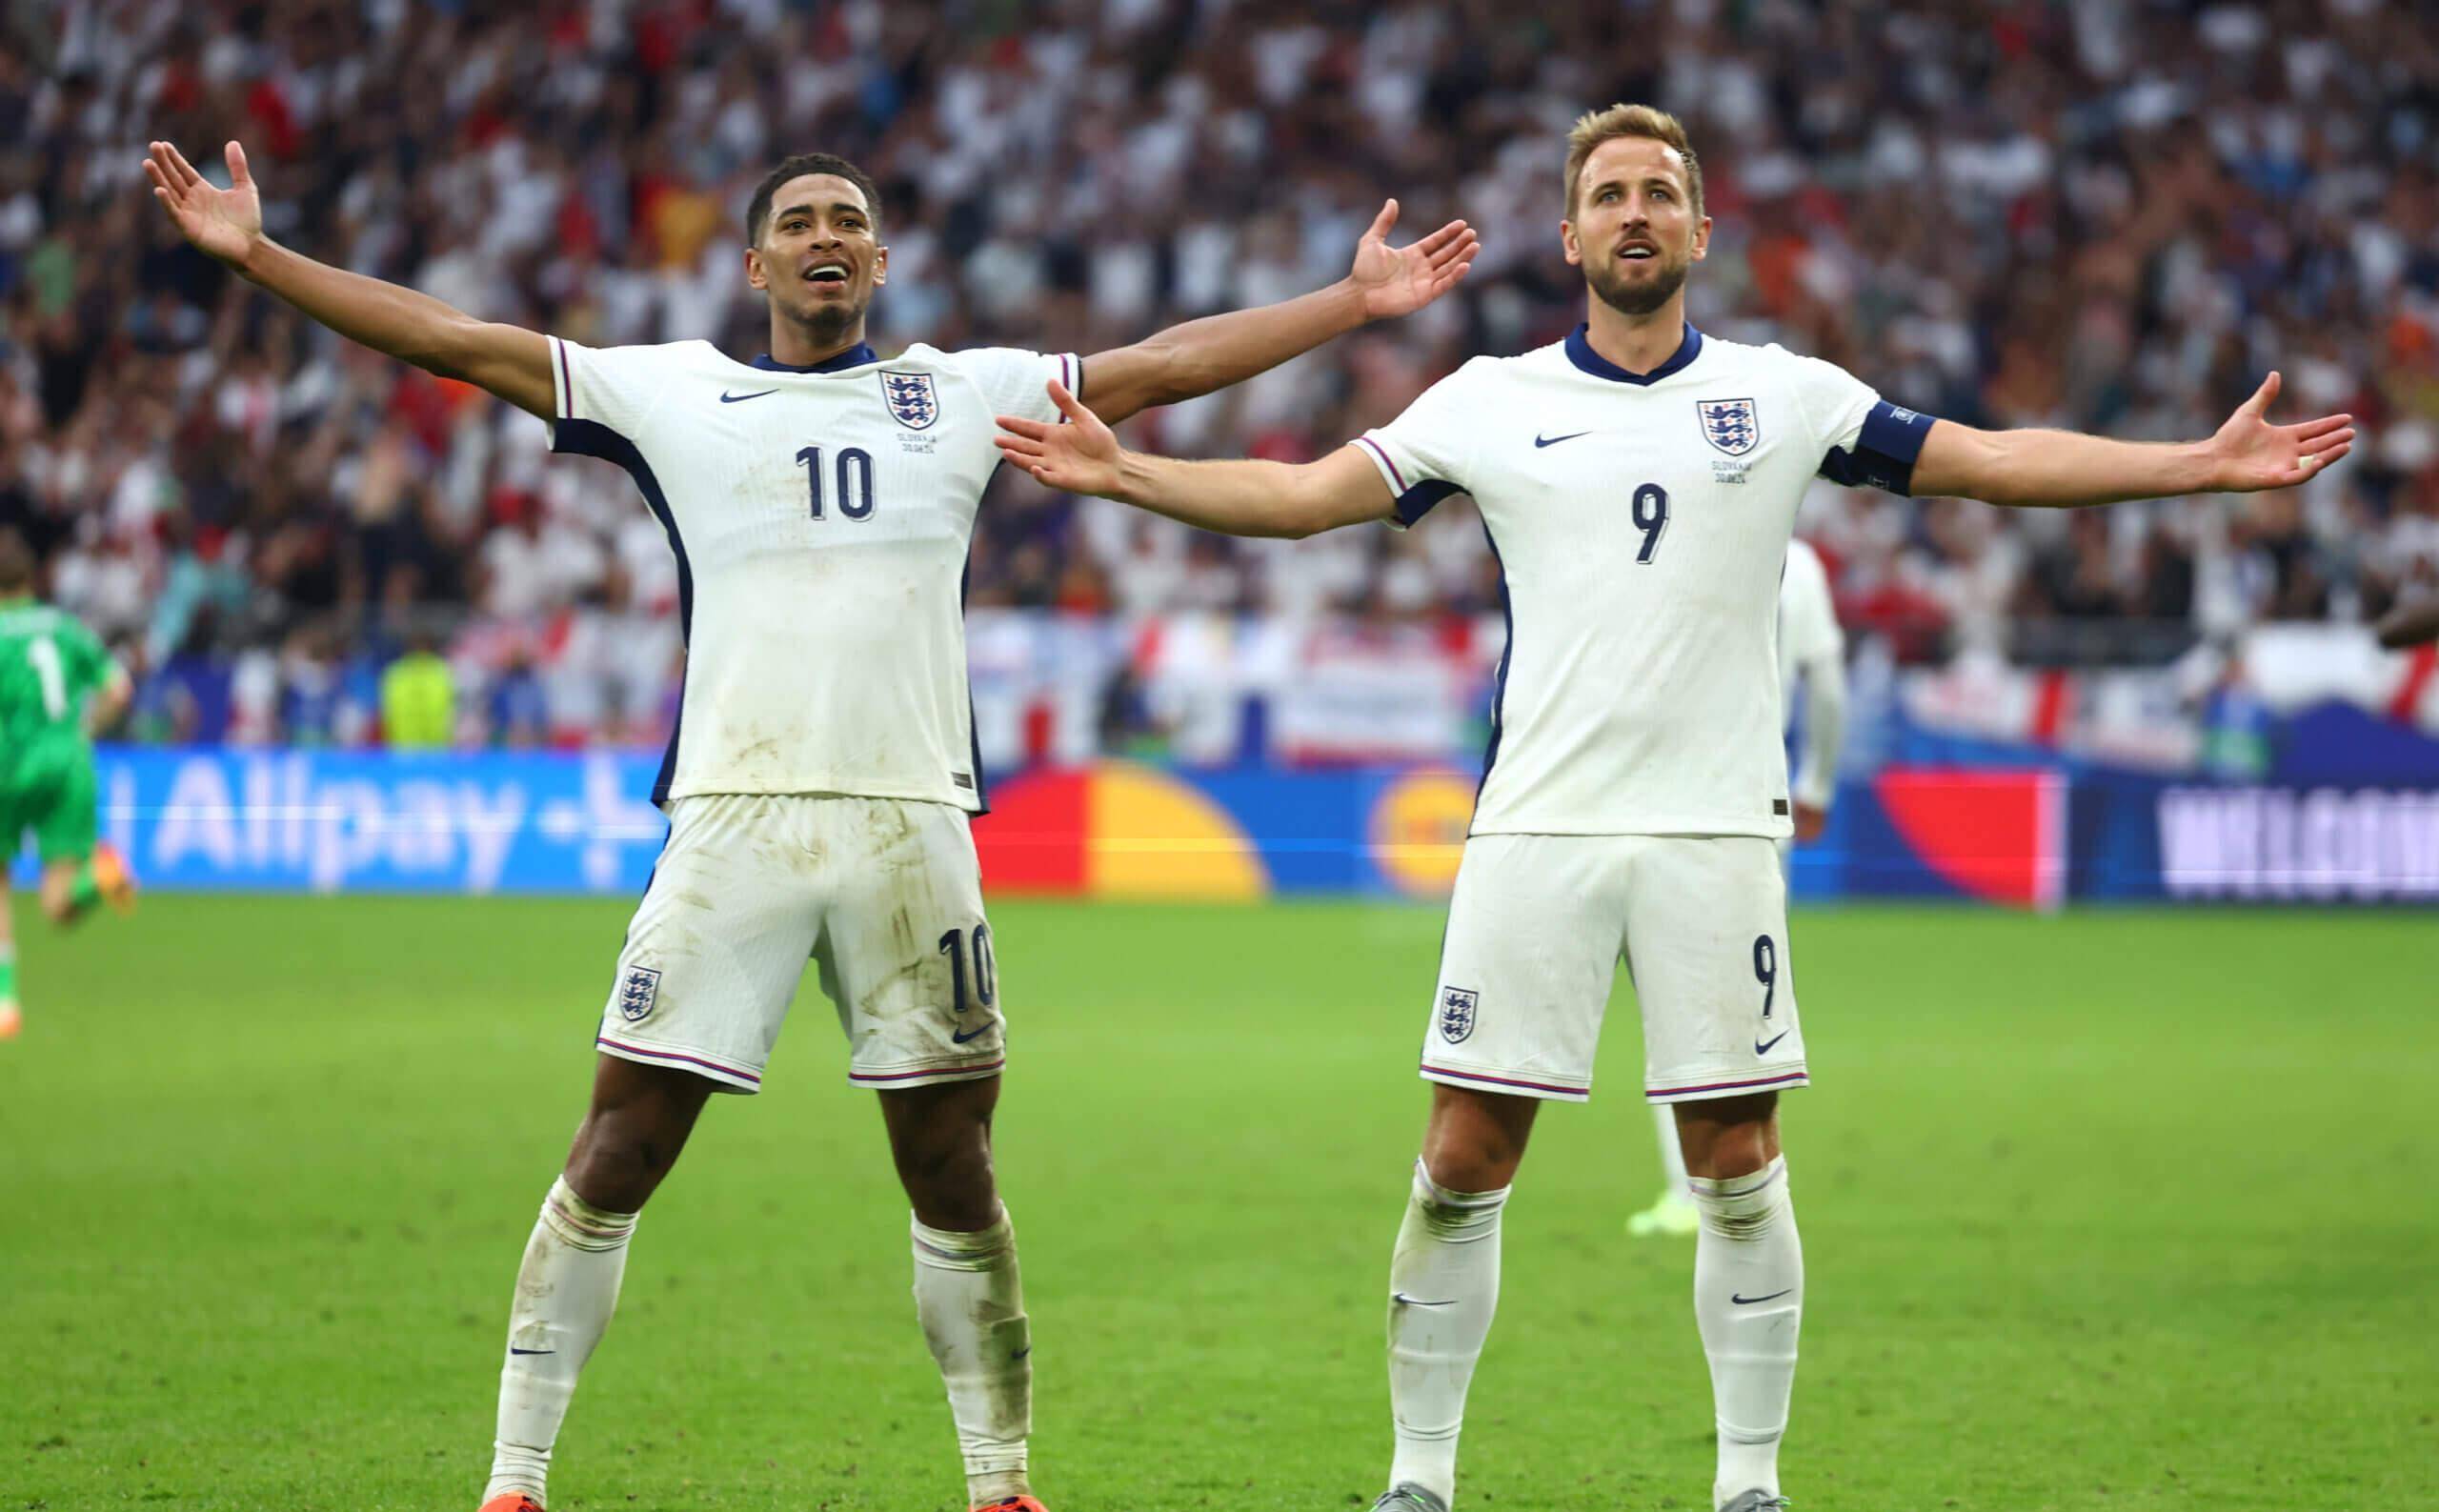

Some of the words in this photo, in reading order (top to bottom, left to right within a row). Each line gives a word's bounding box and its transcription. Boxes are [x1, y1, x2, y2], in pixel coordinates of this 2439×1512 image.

[796, 446, 876, 522] 10
[1632, 482, 1670, 564] 9
[27, 636, 66, 721] 1
[938, 923, 995, 1013] 10
[1753, 934, 1776, 1019] 9
